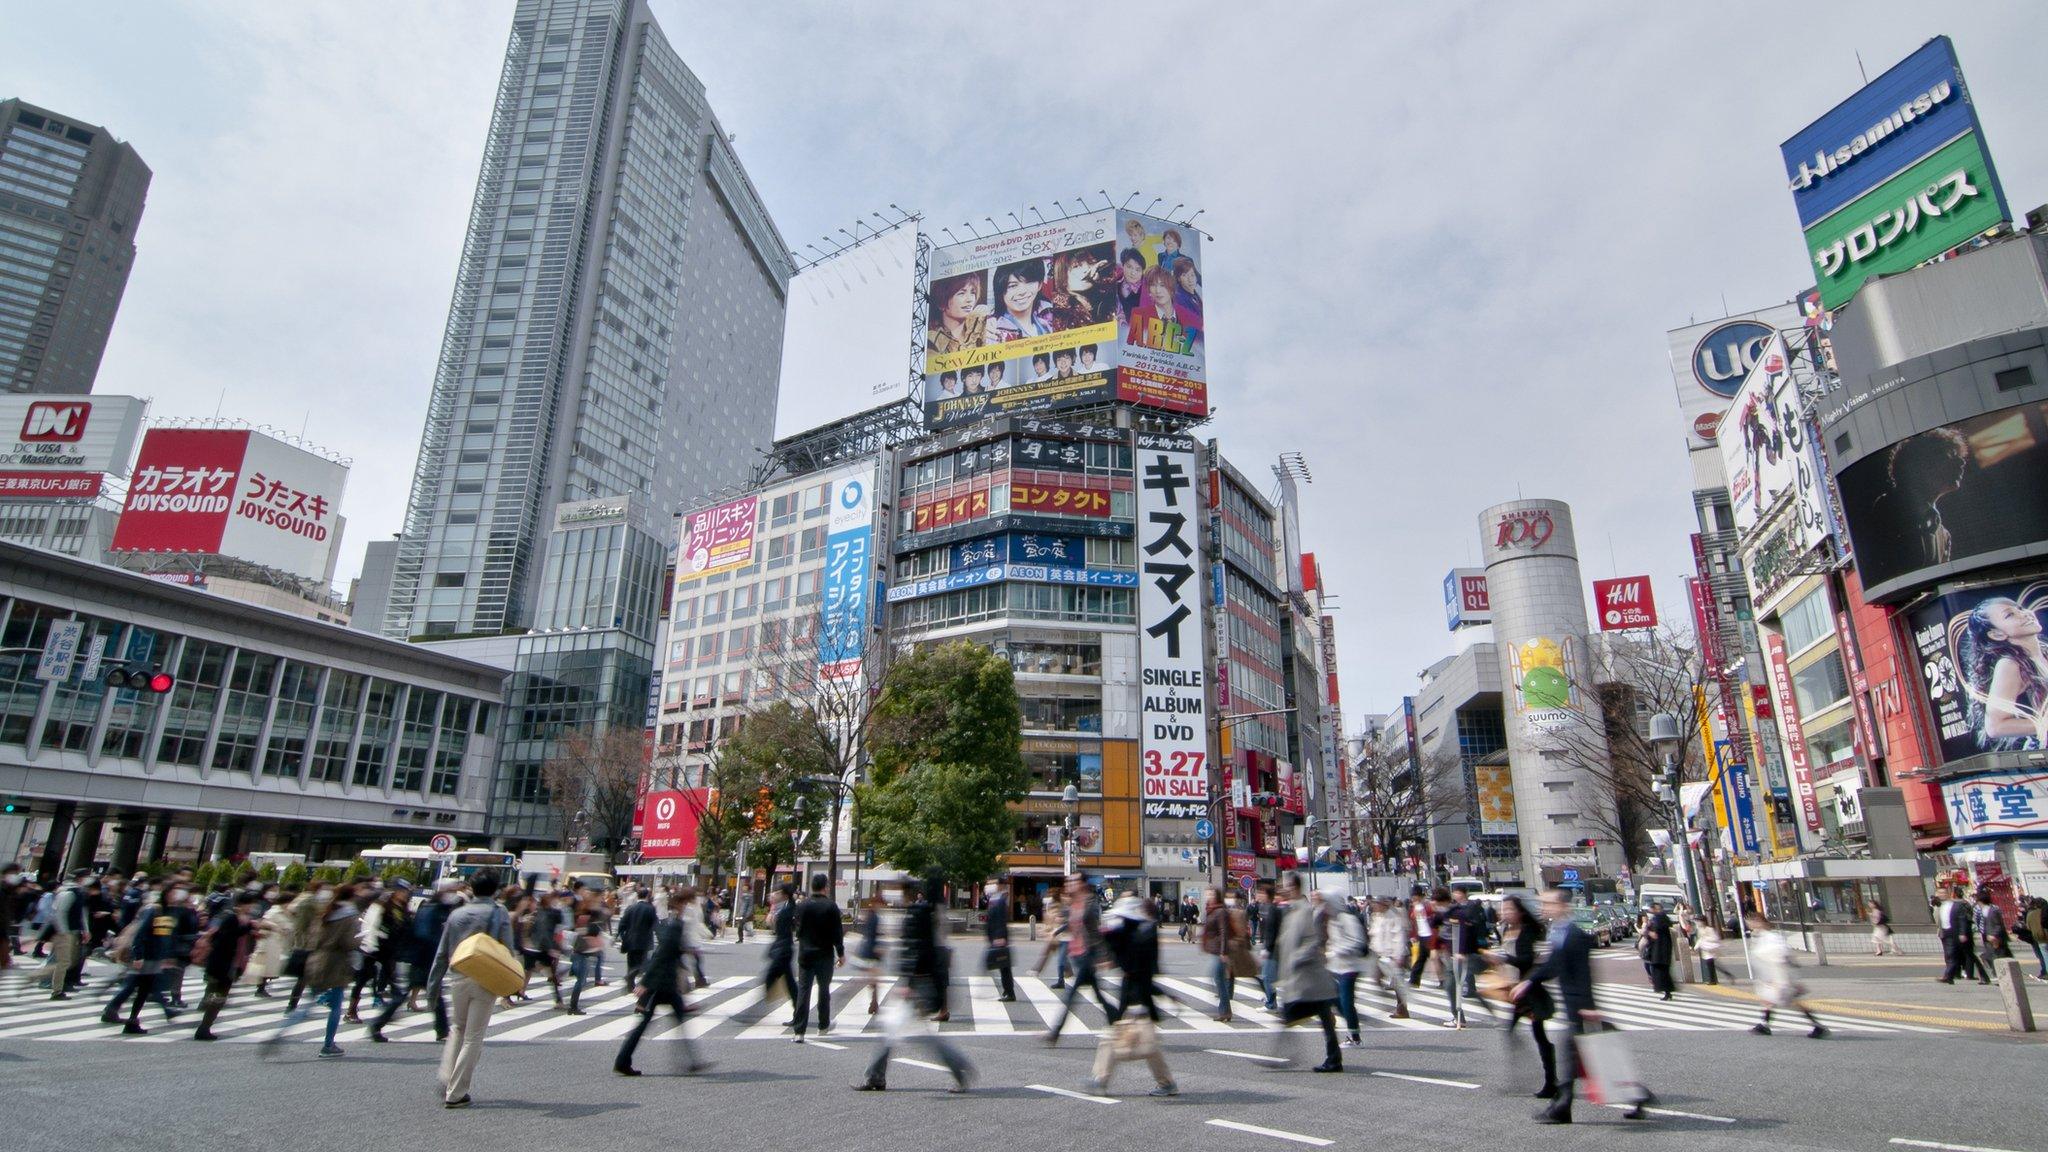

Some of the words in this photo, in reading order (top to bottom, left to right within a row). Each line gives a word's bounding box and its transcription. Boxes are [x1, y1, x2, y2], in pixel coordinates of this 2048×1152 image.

[1788, 79, 1951, 191] Hisamitsu
[1814, 167, 1980, 277] サロンパス
[1007, 236, 1022, 245] DVD
[1064, 228, 1105, 247] Zone
[1135, 361, 1172, 374] 2013.3.6
[1842, 392, 1868, 412] Vision
[1871, 376, 1906, 395] SHIBUYA
[19, 454, 86, 465] MasterCard
[35, 443, 61, 453] VISA
[135, 465, 235, 494] カラオケ
[1784, 402, 1824, 534] もんじゃ
[128, 494, 229, 513] JOYSOUND
[246, 472, 329, 521] うたスキ
[1011, 486, 1107, 511] コンタクト
[693, 501, 755, 534] 品川スキン
[916, 491, 987, 526] プライス
[1502, 509, 1550, 520] SHIBUYA
[236, 500, 327, 542] JOYSOUND
[1494, 516, 1554, 549] 109
[692, 520, 754, 552] クリニック
[1142, 454, 1195, 658] キスマイ
[918, 572, 984, 595] 英会話イーオン
[1010, 567, 1044, 578] AEON
[1050, 569, 1136, 584] 英会話イーオン
[889, 587, 914, 599] AEON
[1606, 582, 1639, 605] H&M
[1623, 614, 1649, 623] 150m
[52, 626, 77, 676] 渋谷駅前
[1143, 668, 1202, 687] SINGLE
[1169, 687, 1176, 696] &
[1144, 696, 1202, 714] ALBUM
[1169, 714, 1177, 723] &
[1154, 724, 1194, 741] DVD
[1144, 749, 1205, 777] 3.27
[1146, 779, 1166, 796] ON
[1170, 779, 1206, 797] SALE
[1951, 784, 2039, 825] 大盛堂
